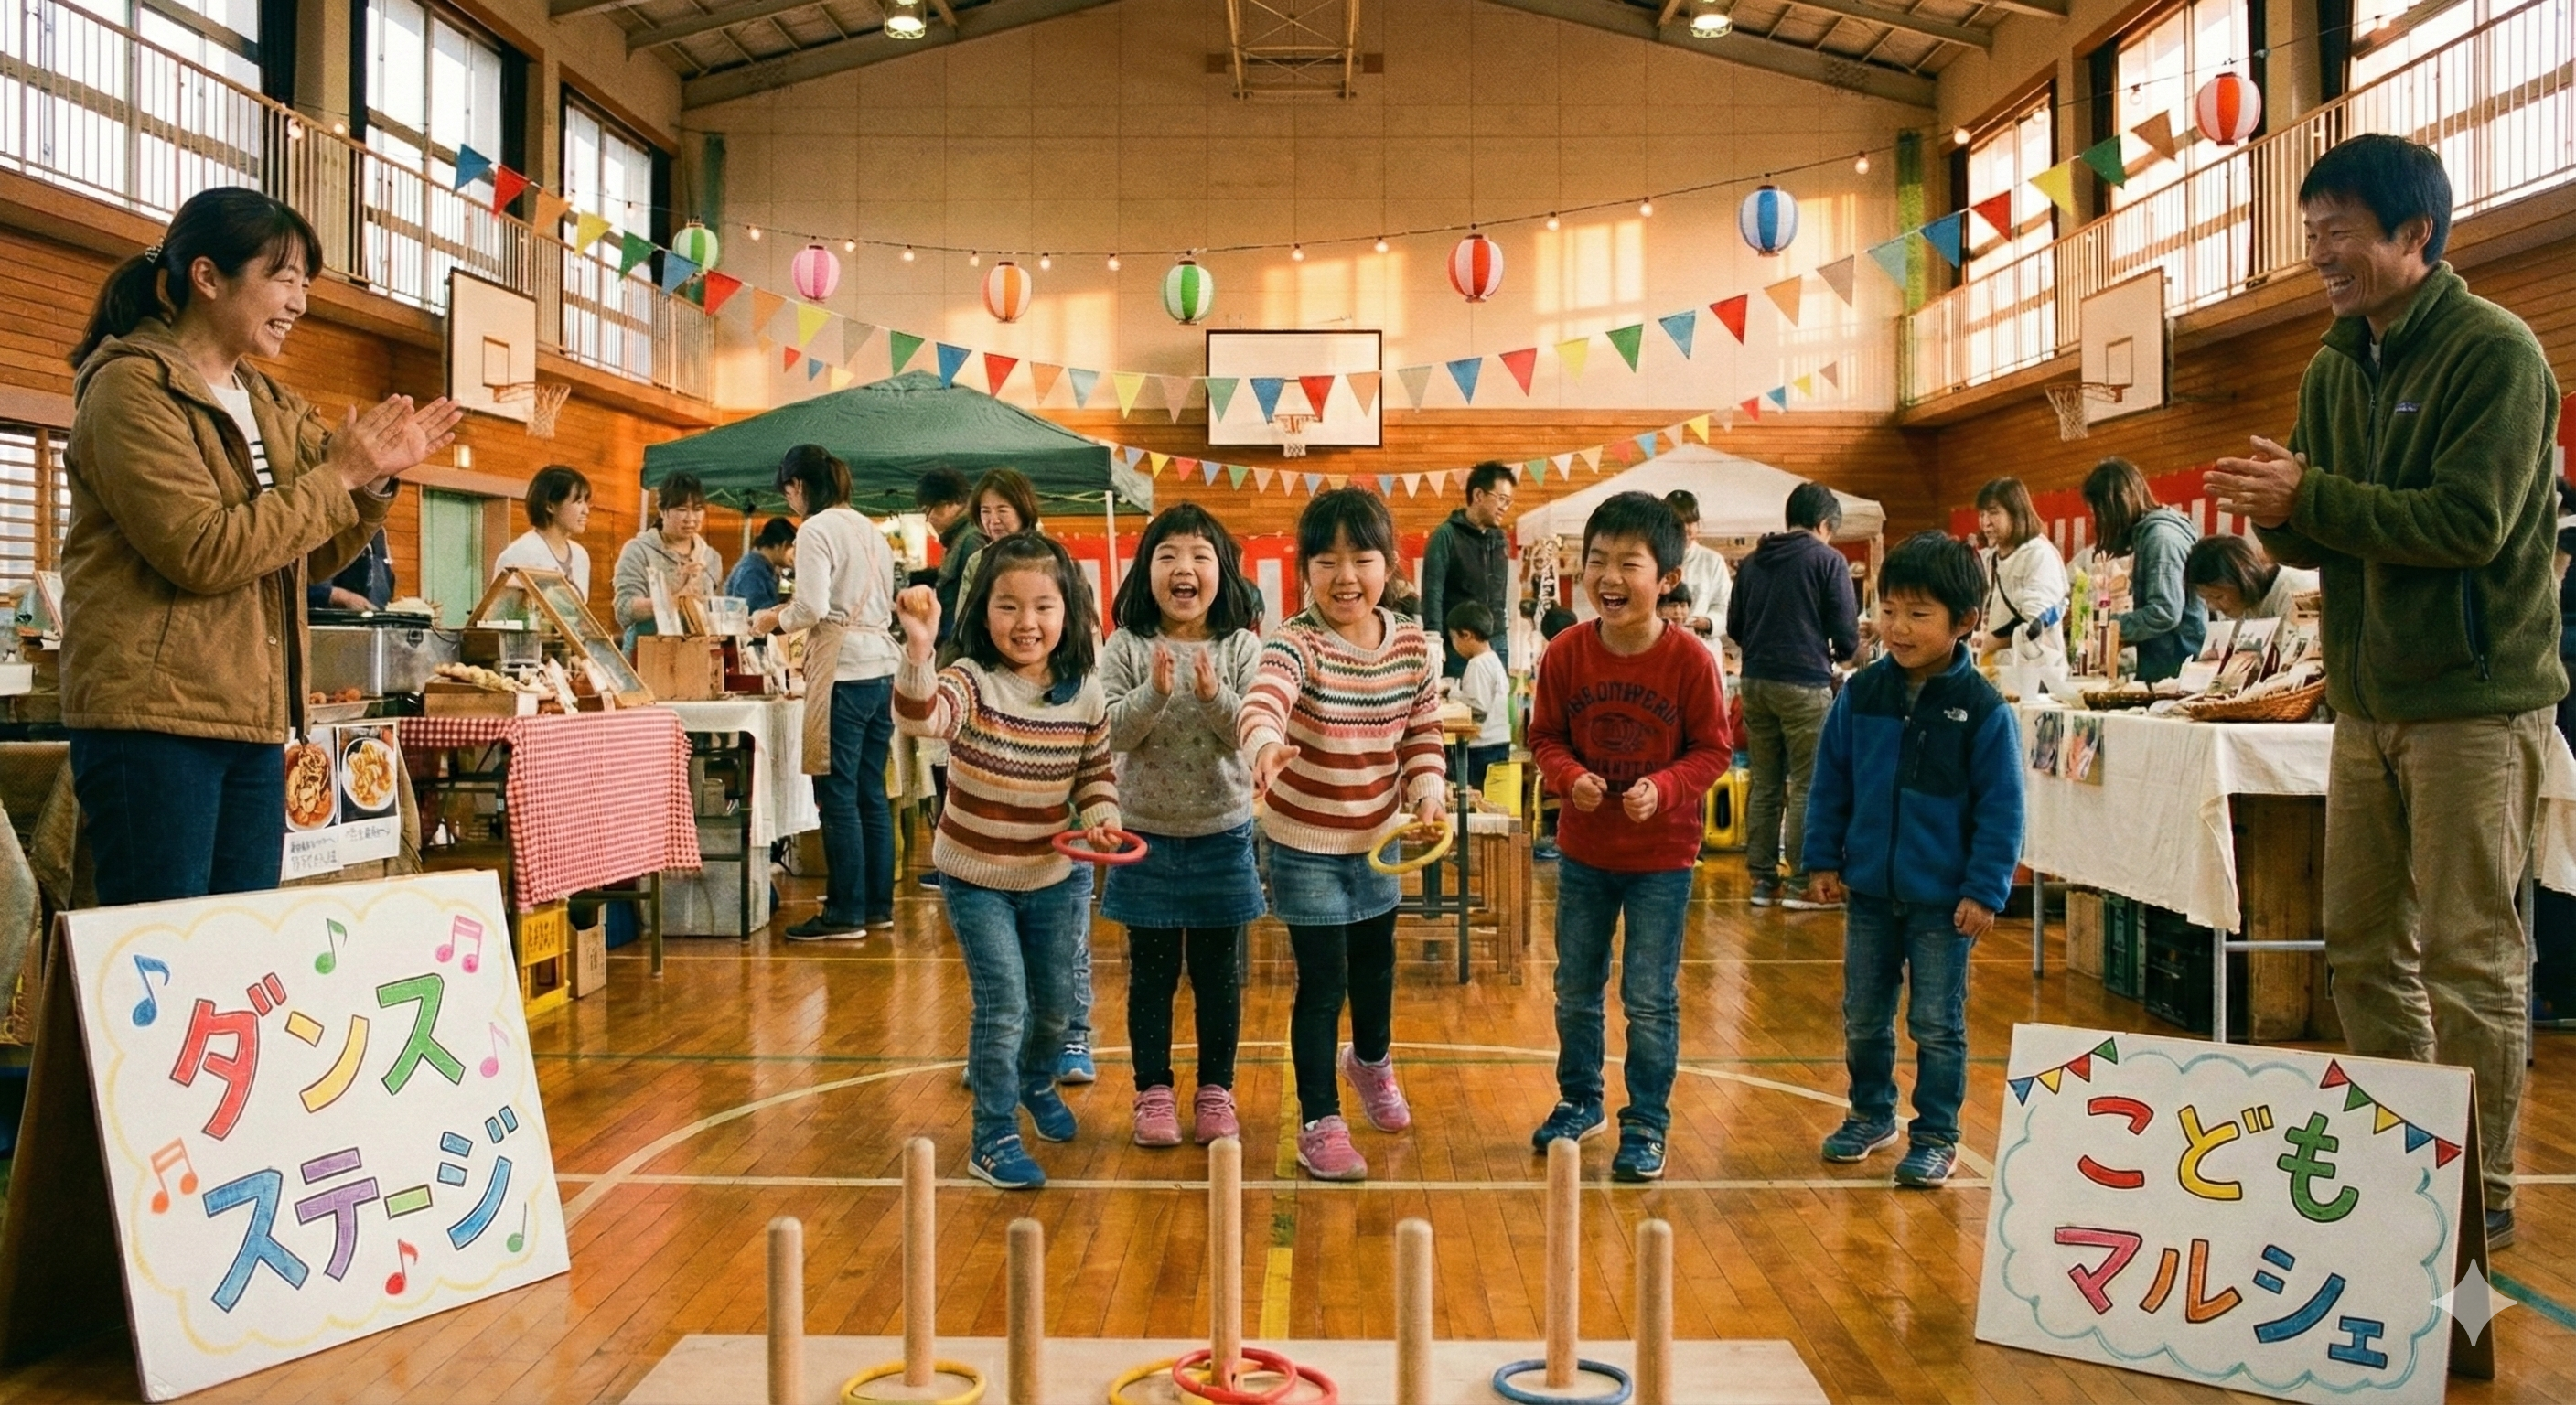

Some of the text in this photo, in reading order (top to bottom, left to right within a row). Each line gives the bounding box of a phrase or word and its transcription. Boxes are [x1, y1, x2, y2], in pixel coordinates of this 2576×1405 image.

[170, 973, 466, 1141] ダンス
[202, 1105, 519, 1314] ステージ
[2077, 1095, 2359, 1223] こども
[2054, 1226, 2388, 1370] マルシェ
